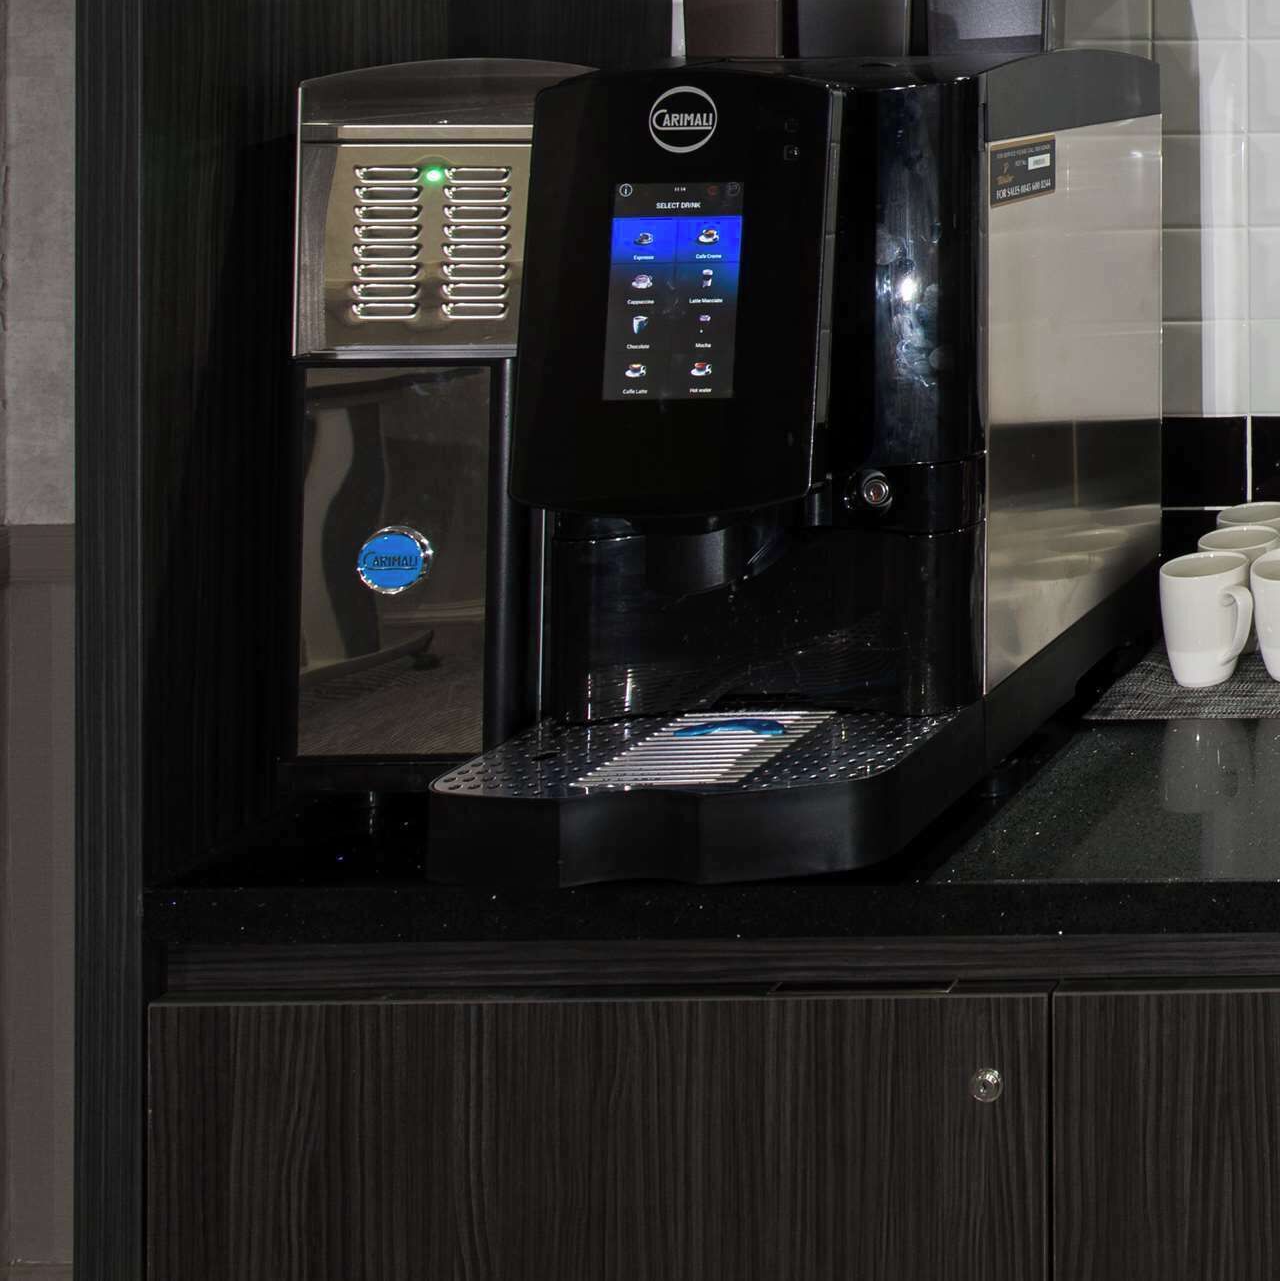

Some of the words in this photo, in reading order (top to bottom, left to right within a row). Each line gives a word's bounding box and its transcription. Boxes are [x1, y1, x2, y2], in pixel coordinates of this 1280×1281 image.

[652, 109, 713, 130] CARIMALI
[1007, 184, 1020, 197] SALES
[363, 550, 418, 570] CARIMALI
